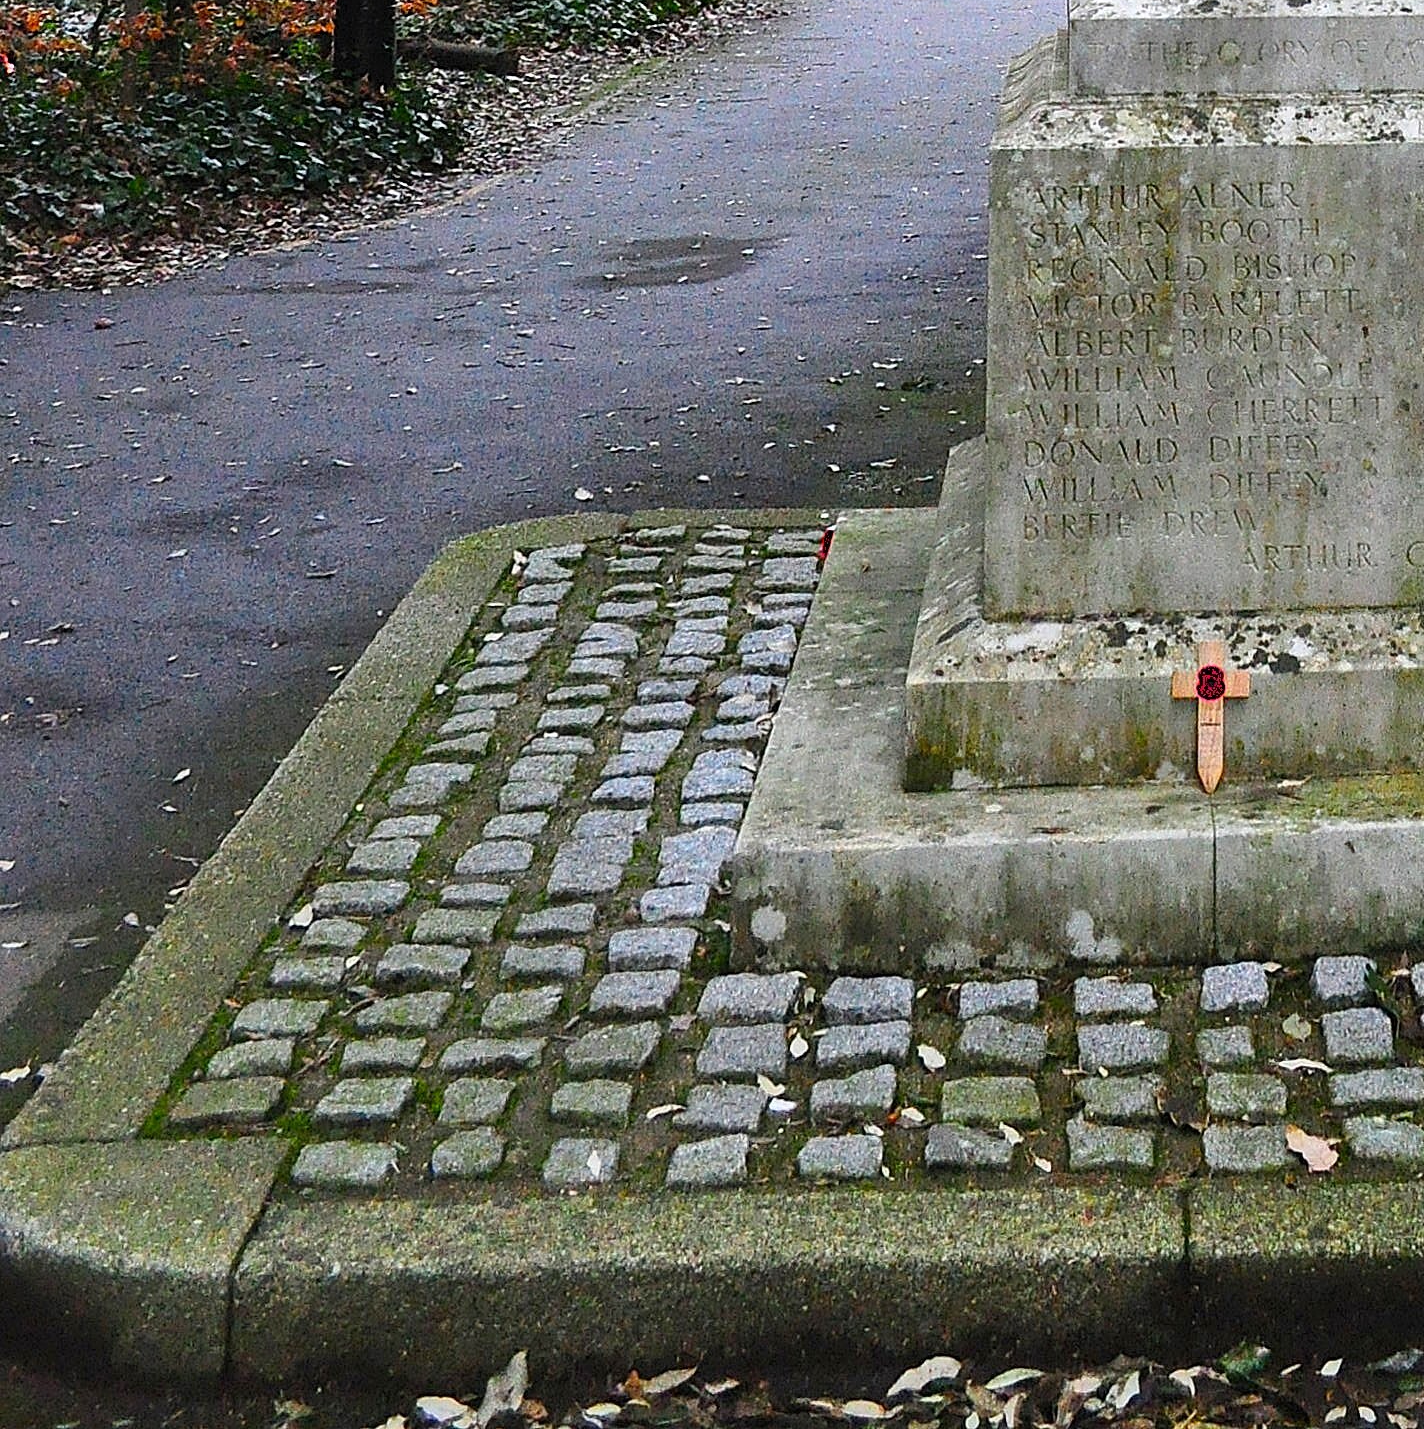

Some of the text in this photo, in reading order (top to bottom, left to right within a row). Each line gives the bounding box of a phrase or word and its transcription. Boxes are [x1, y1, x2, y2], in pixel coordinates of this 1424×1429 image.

[1330, 37, 1369, 63] OF
[1030, 181, 1302, 211] ARTHUR ALNER
[1028, 217, 1321, 249] STANLEY BOOTH
[1026, 252, 1358, 282] REGINALD BISHOP
[1026, 288, 1362, 320] VICTOR BARTLETT
[1033, 325, 1327, 357] ALBERT BURDEN
[1024, 365, 1180, 393] WILLIAM
[1024, 396, 1385, 429] WILLIAM CHERRETT
[1023, 434, 1323, 468] DONALD DIFFEY
[1022, 469, 1326, 504] WILLIAM DIFFEY
[1022, 507, 1263, 541] BERTIE DREW
[1242, 541, 1375, 572] ARTHUR
